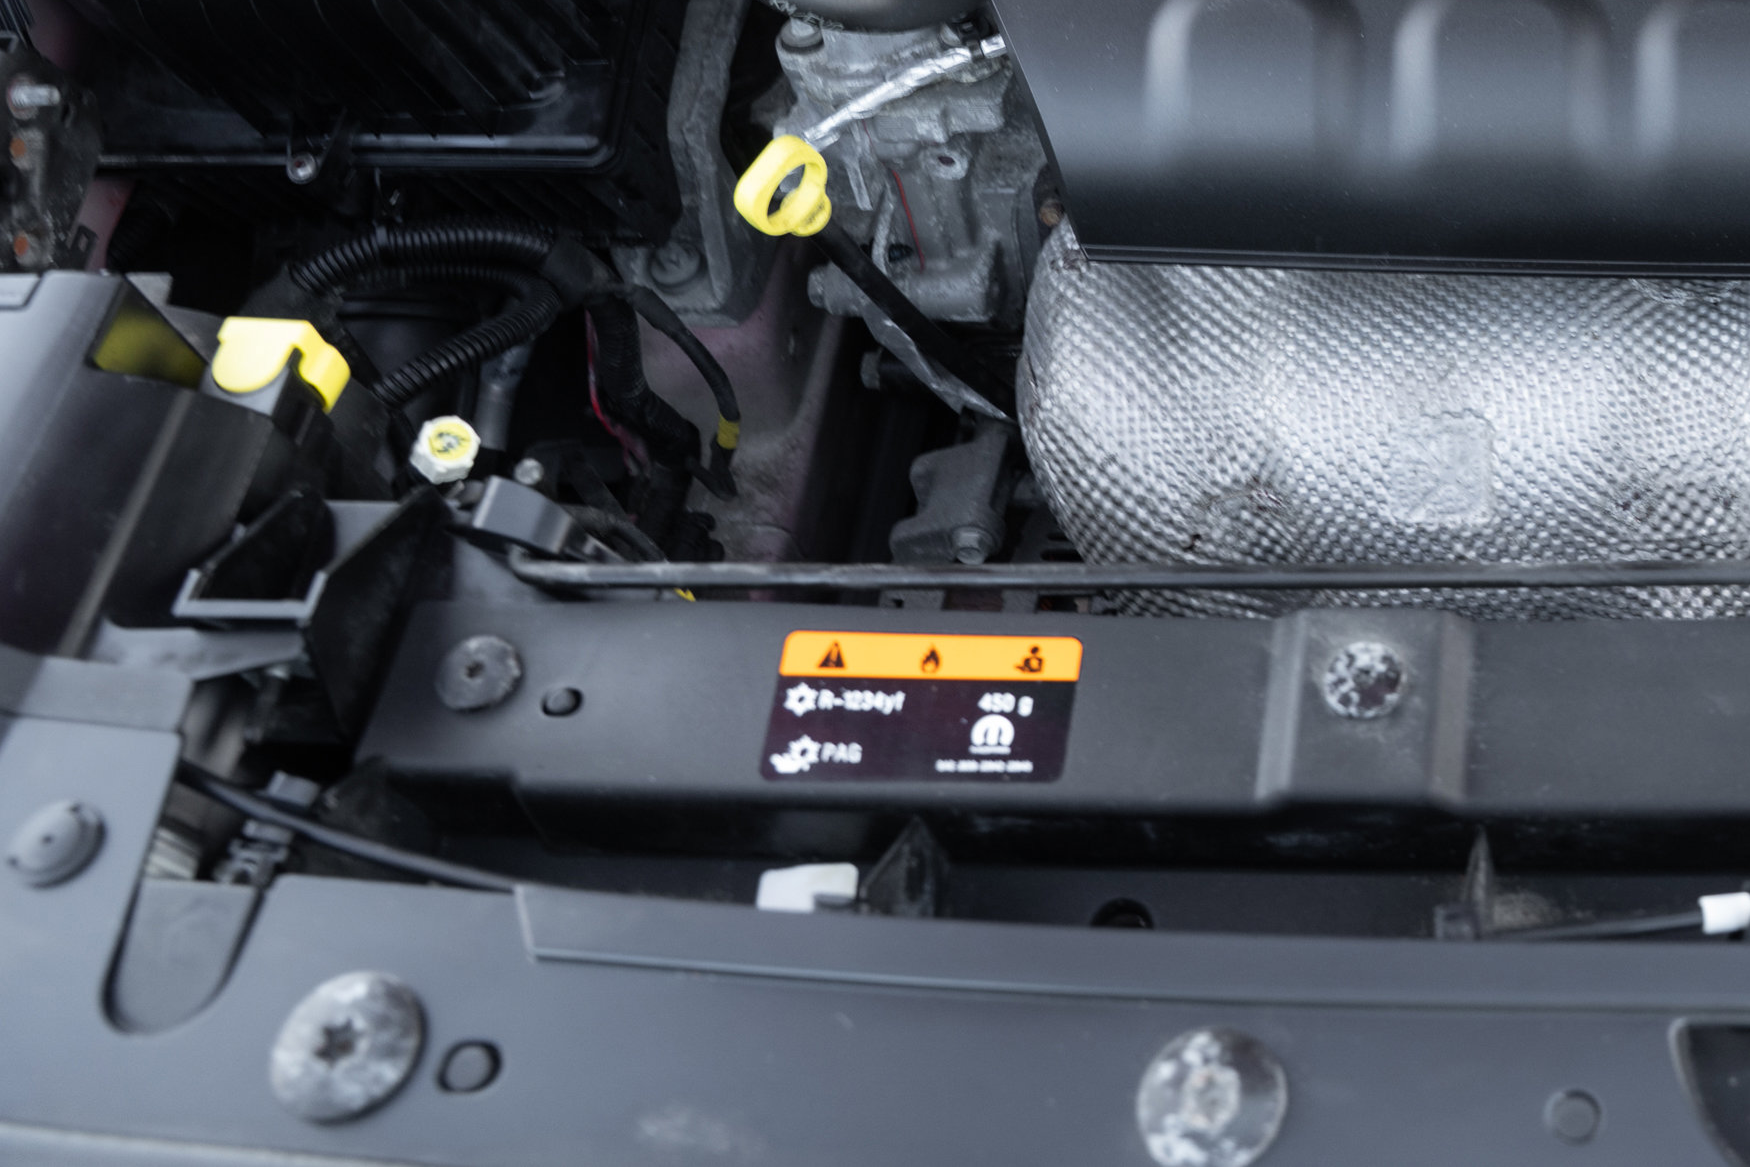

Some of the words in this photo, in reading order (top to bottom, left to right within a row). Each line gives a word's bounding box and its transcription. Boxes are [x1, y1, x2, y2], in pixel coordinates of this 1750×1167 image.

[816, 688, 906, 716] R-1234yf
[977, 692, 1015, 713] 450
[820, 742, 864, 764] PAG
